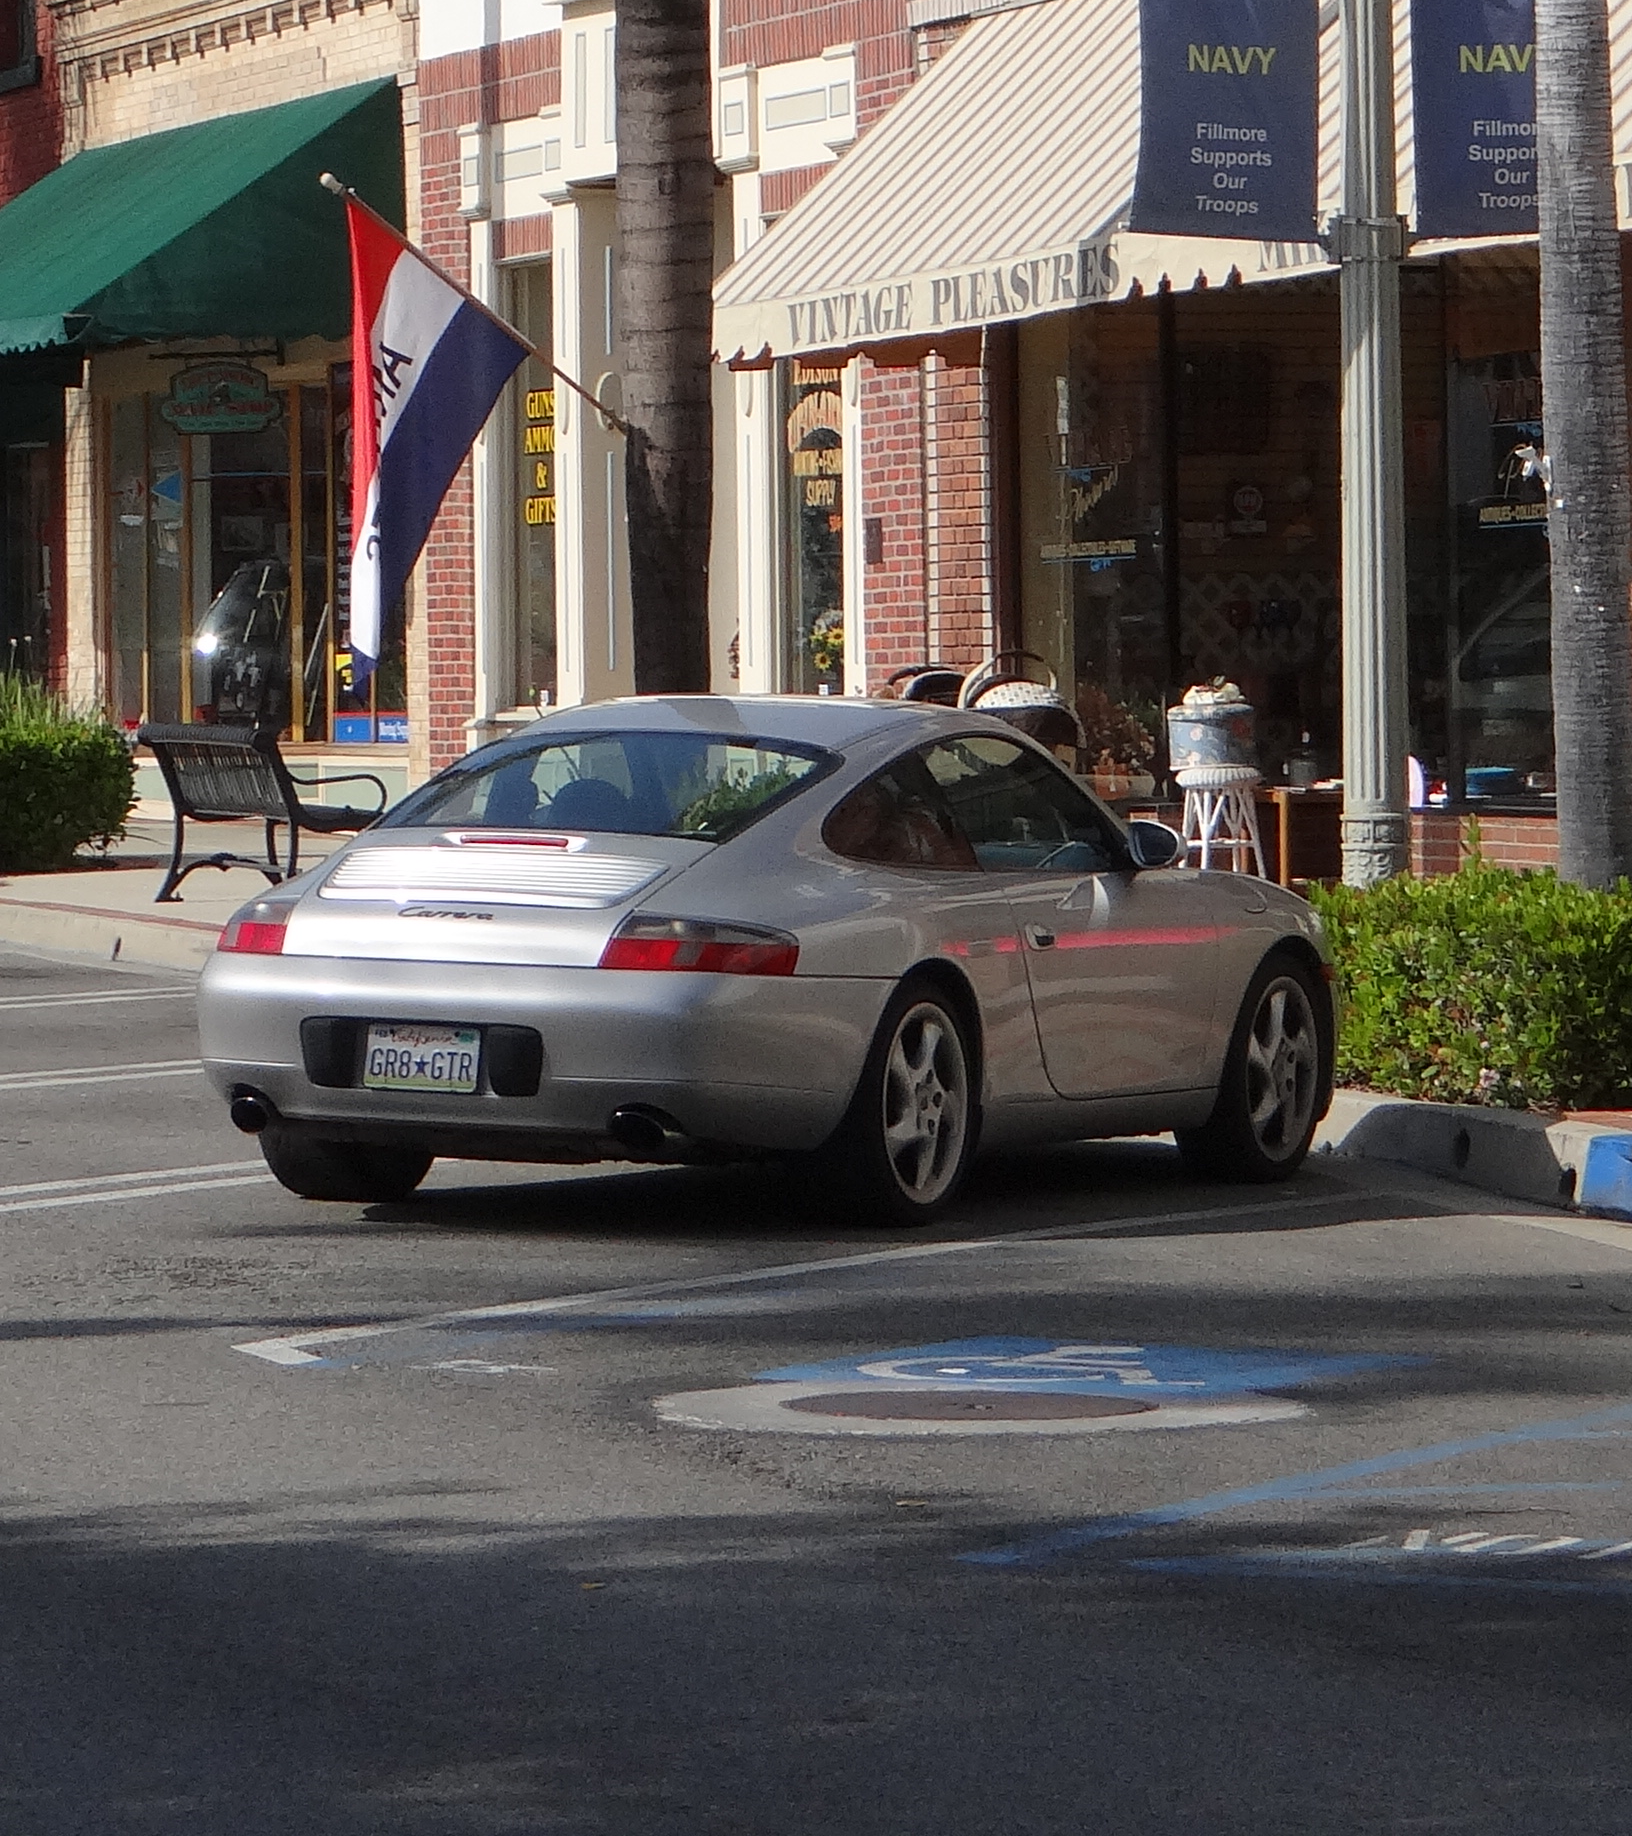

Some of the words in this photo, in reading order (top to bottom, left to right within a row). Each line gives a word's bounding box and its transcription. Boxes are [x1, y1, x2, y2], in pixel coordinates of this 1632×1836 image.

[1187, 43, 1276, 75] NAVY
[1459, 43, 1536, 73] NAV
[1196, 122, 1267, 142] Fillmore
[1190, 147, 1272, 167] Supports
[1213, 172, 1247, 190] Our
[1494, 168, 1530, 185] Our
[1195, 195, 1259, 214] Troops
[1478, 192, 1539, 210] Troops
[787, 280, 914, 348] VINTAGE
[929, 243, 1120, 327] PLEASURES
[536, 462, 547, 489] &
[806, 479, 836, 506] SUPPLY
[398, 905, 494, 921] Carrera
